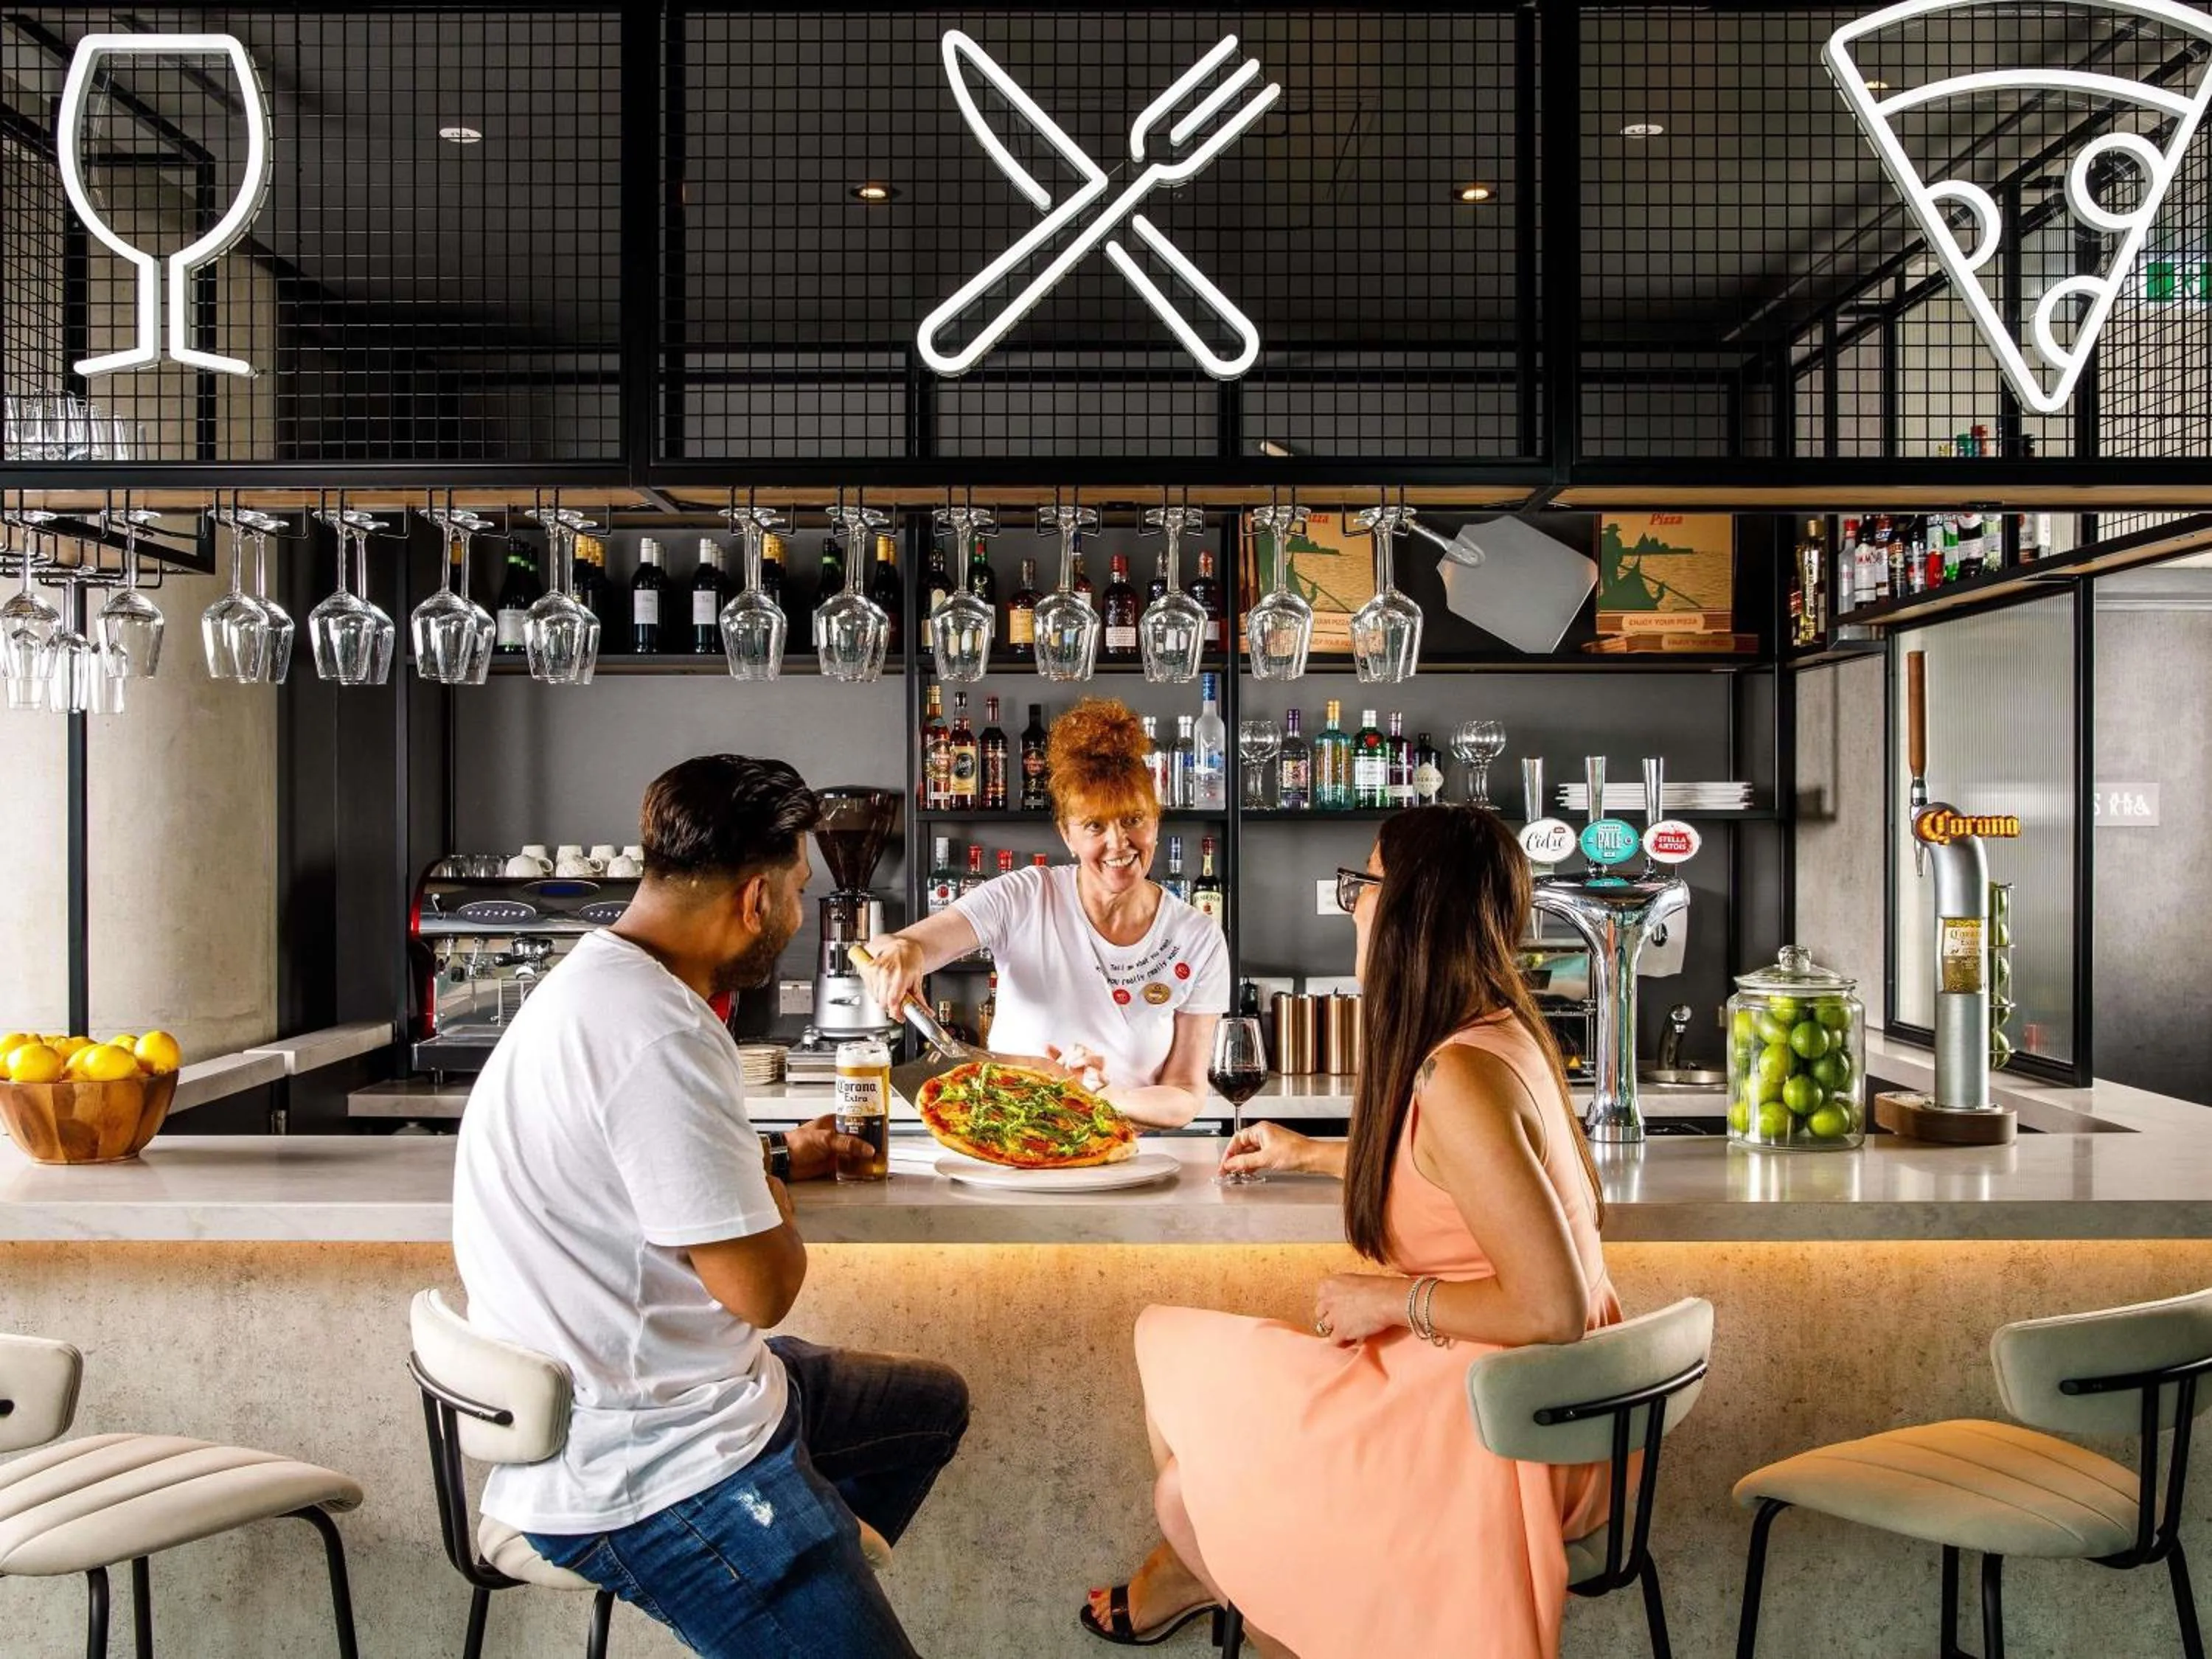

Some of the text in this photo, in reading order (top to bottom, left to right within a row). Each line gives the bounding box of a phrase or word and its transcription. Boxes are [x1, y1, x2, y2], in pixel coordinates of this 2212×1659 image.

[1649, 513, 1683, 525] Pizza
[1629, 618, 1652, 626] ENJOY
[1655, 618, 1675, 626] YOUR
[1917, 810, 2019, 844] Corona
[1526, 830, 1565, 852] Cidre
[1598, 831, 1622, 849] PALE
[838, 1079, 877, 1093] Corona
[844, 1093, 868, 1102] Extra
